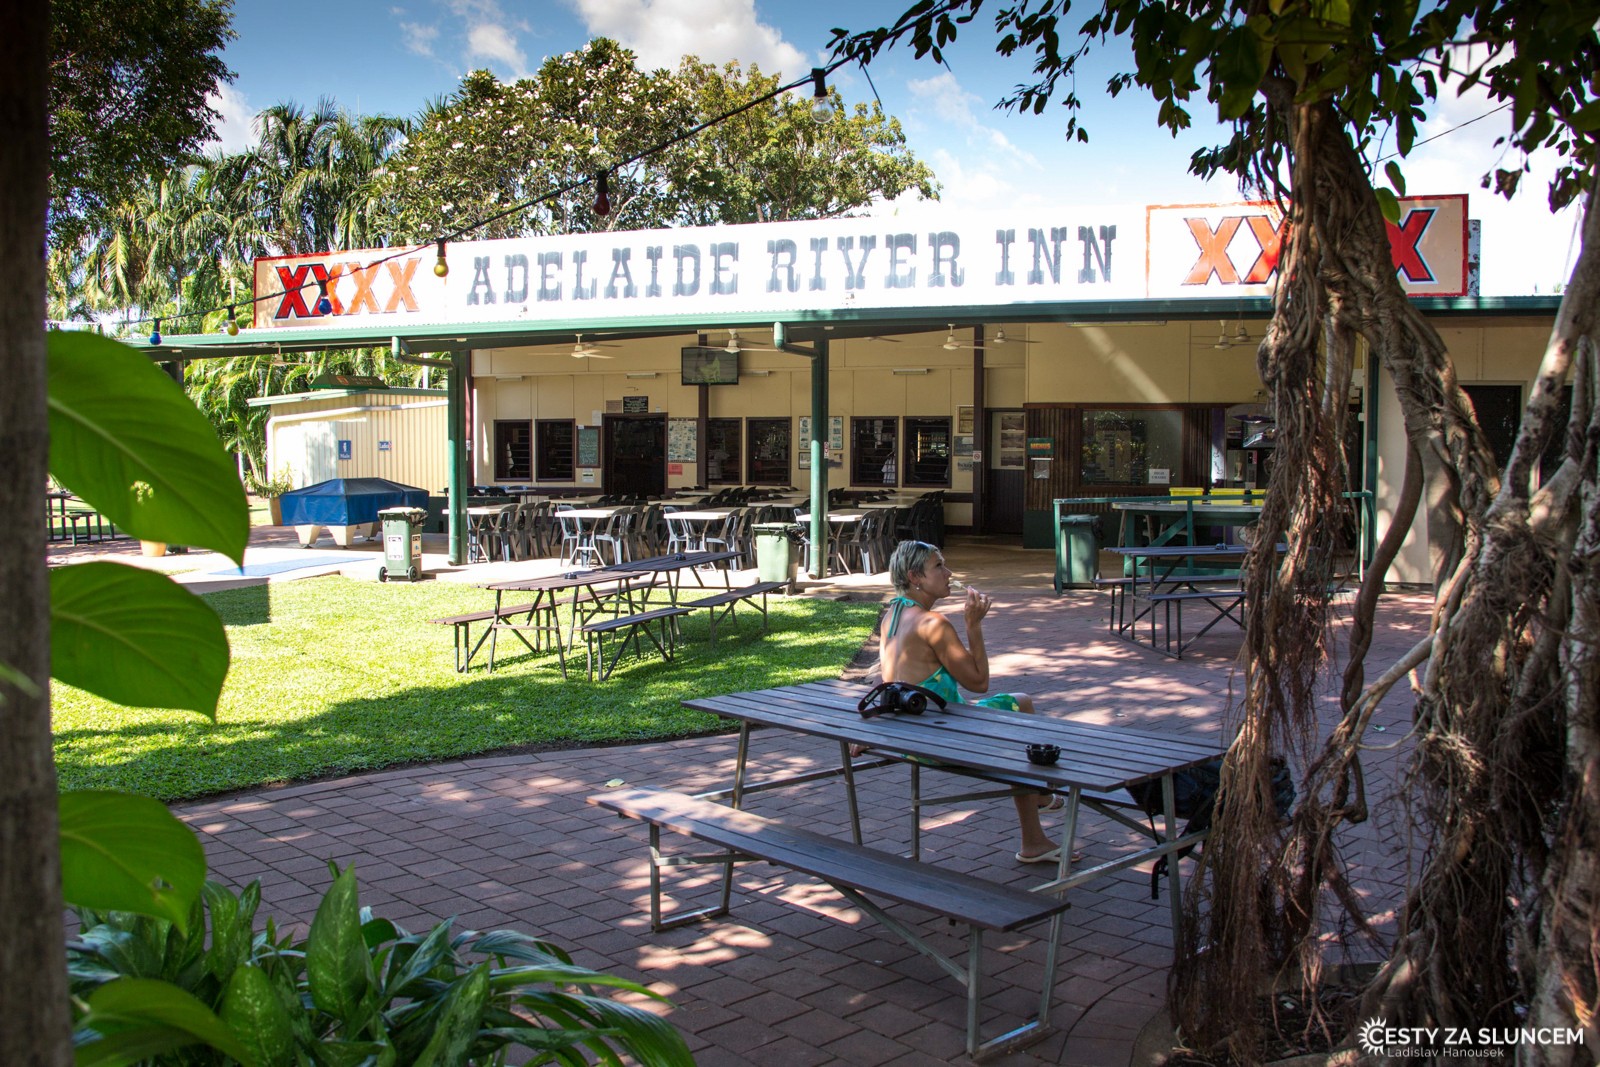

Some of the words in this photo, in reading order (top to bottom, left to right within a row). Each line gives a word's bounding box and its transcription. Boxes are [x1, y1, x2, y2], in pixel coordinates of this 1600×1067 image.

[466, 242, 739, 306] ADELAIDE
[766, 231, 965, 293] RIVER
[995, 225, 1117, 286] INN
[1181, 206, 1439, 287] XXX
[274, 257, 422, 319] XXXX
